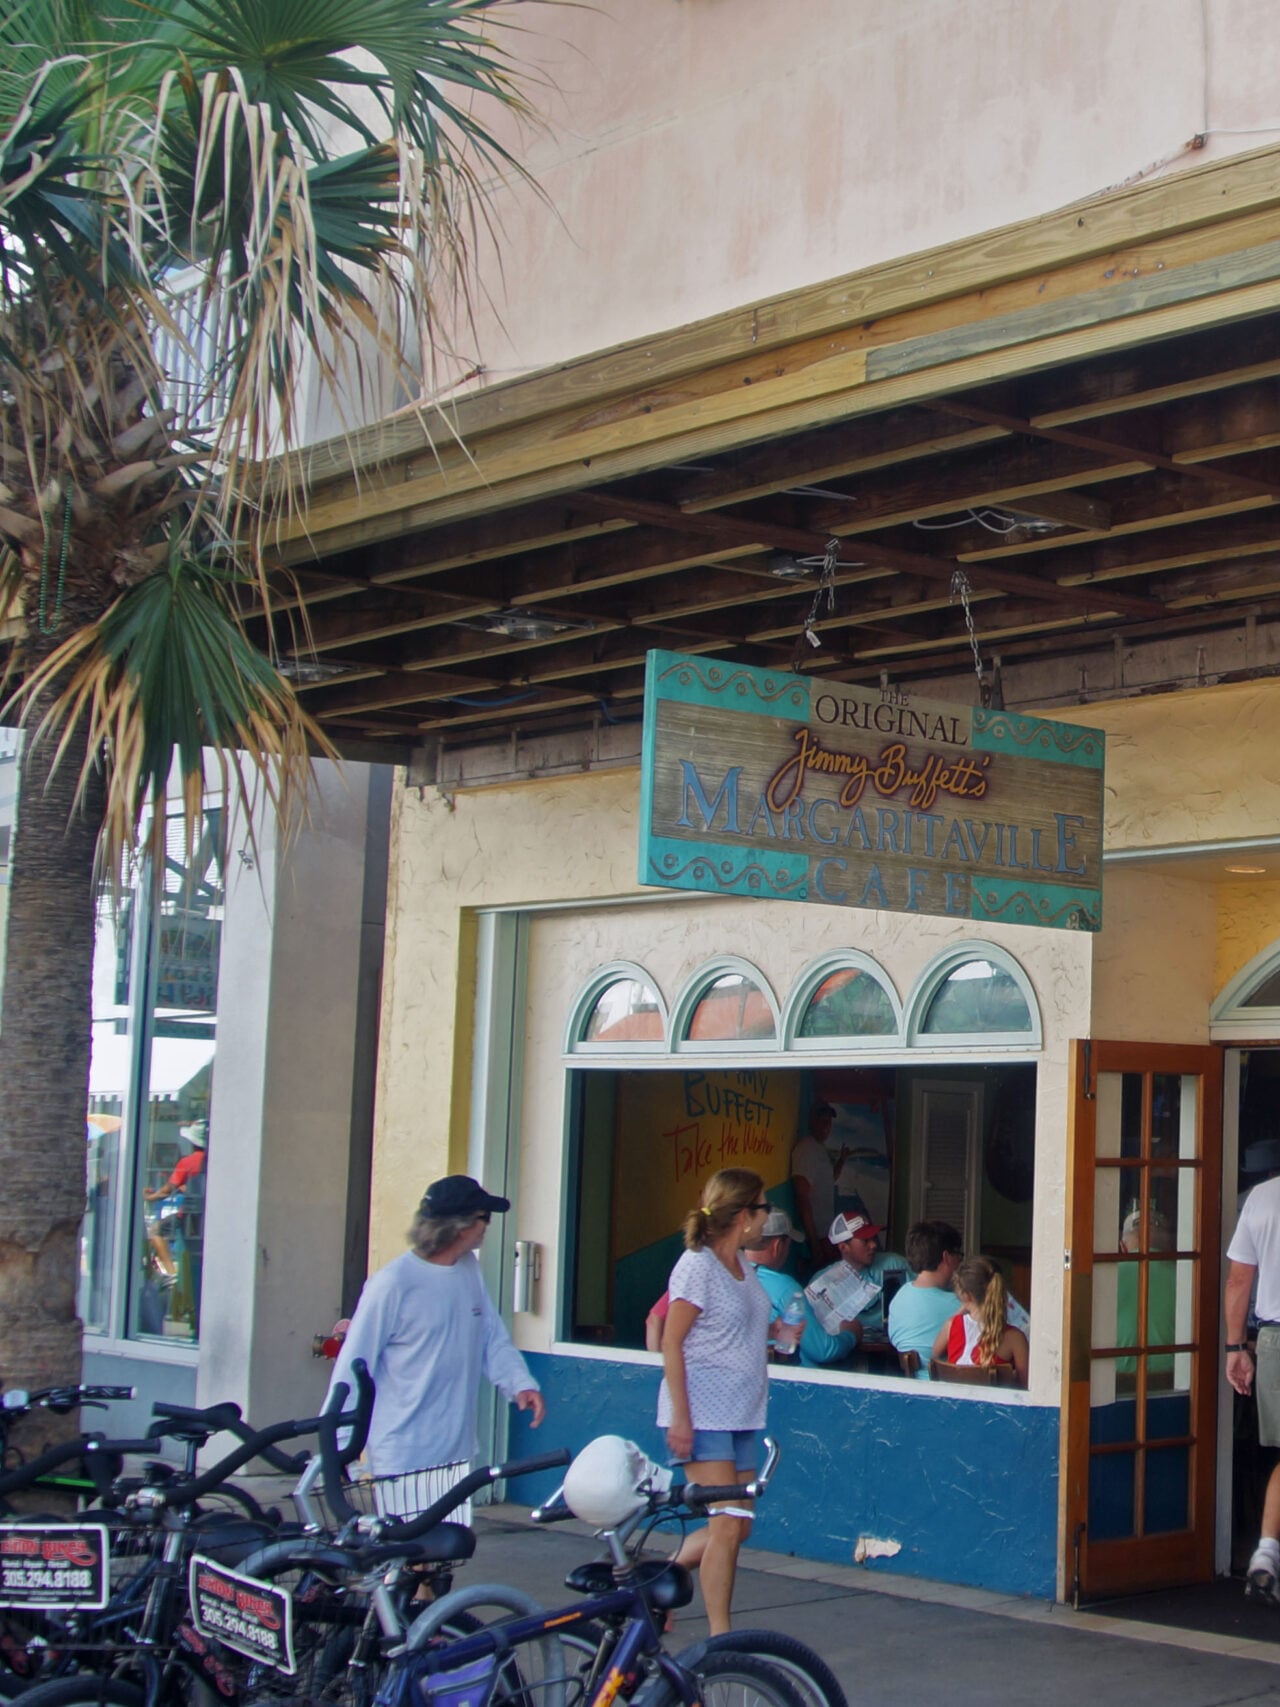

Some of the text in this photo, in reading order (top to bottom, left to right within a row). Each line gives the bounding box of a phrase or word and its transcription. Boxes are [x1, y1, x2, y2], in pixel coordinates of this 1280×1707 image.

[815, 694, 969, 746] ORIGINAL
[880, 689, 910, 706] THE
[767, 729, 989, 813] Jimmy Buffett's
[674, 758, 1087, 875] MARGARITAVILLE
[815, 856, 968, 915] CAFE
[684, 1070, 774, 1128] BUFFETT
[662, 1122, 713, 1183] Take
[716, 1122, 739, 1162] the
[2, 1569, 92, 1588] 305.294.8188
